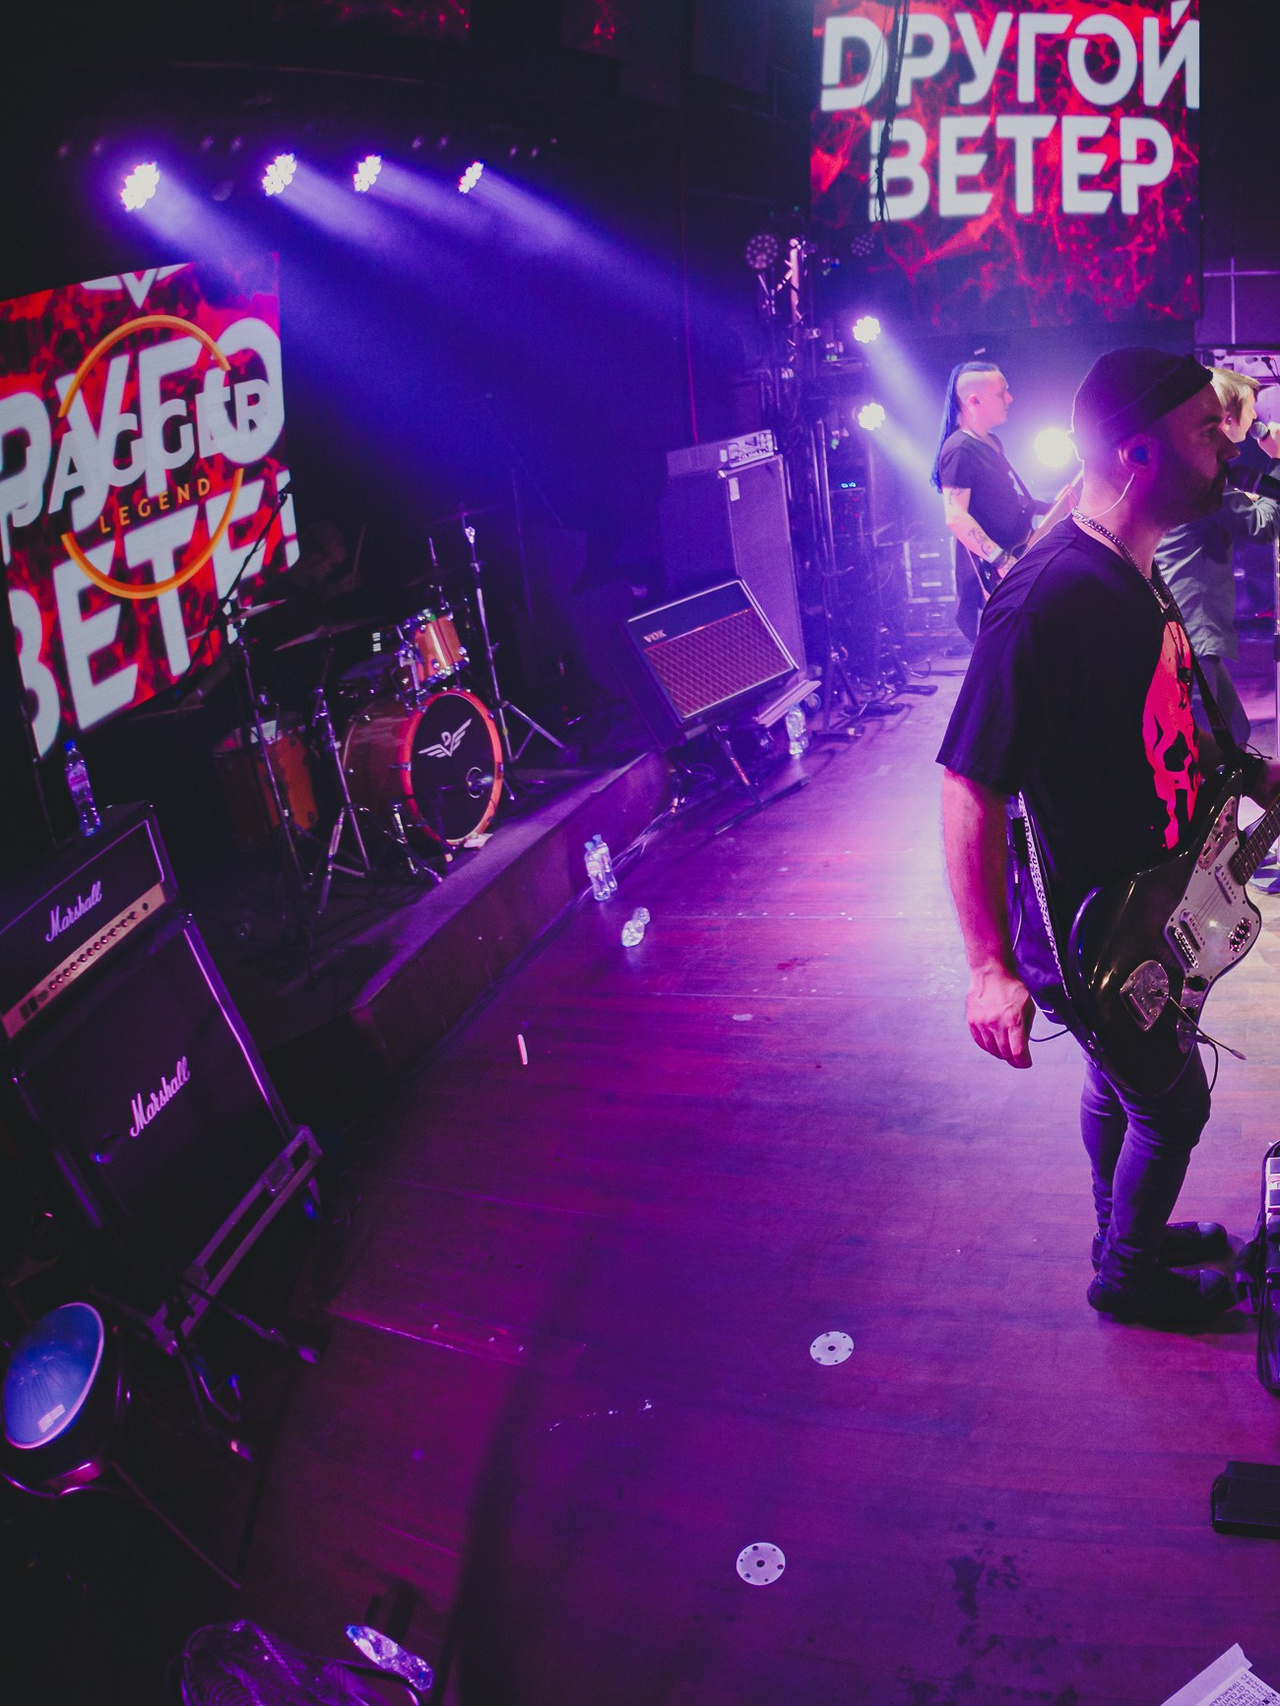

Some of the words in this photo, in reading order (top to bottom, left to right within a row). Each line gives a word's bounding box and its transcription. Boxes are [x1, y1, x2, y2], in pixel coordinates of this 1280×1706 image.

[868, 115, 1175, 222] ВЕТЕР
[100, 477, 211, 534] LEGEND
[643, 629, 667, 643] VOX
[45, 880, 103, 943] Marshall
[130, 1055, 191, 1137] Marshall
